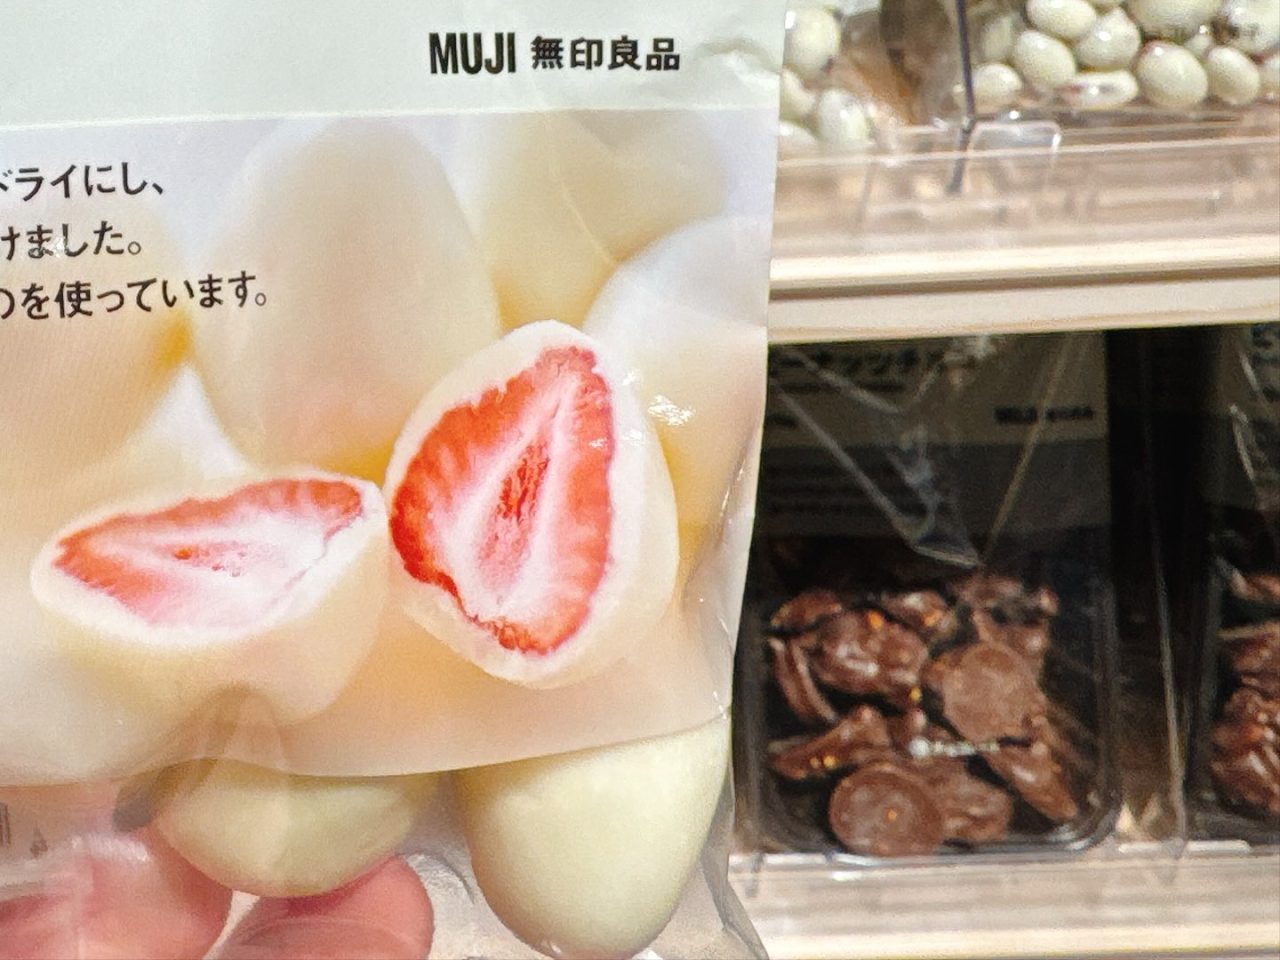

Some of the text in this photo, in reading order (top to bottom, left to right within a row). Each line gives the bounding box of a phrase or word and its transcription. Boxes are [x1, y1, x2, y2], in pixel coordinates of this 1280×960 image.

[429, 31, 681, 75] MUJI 無印良品
